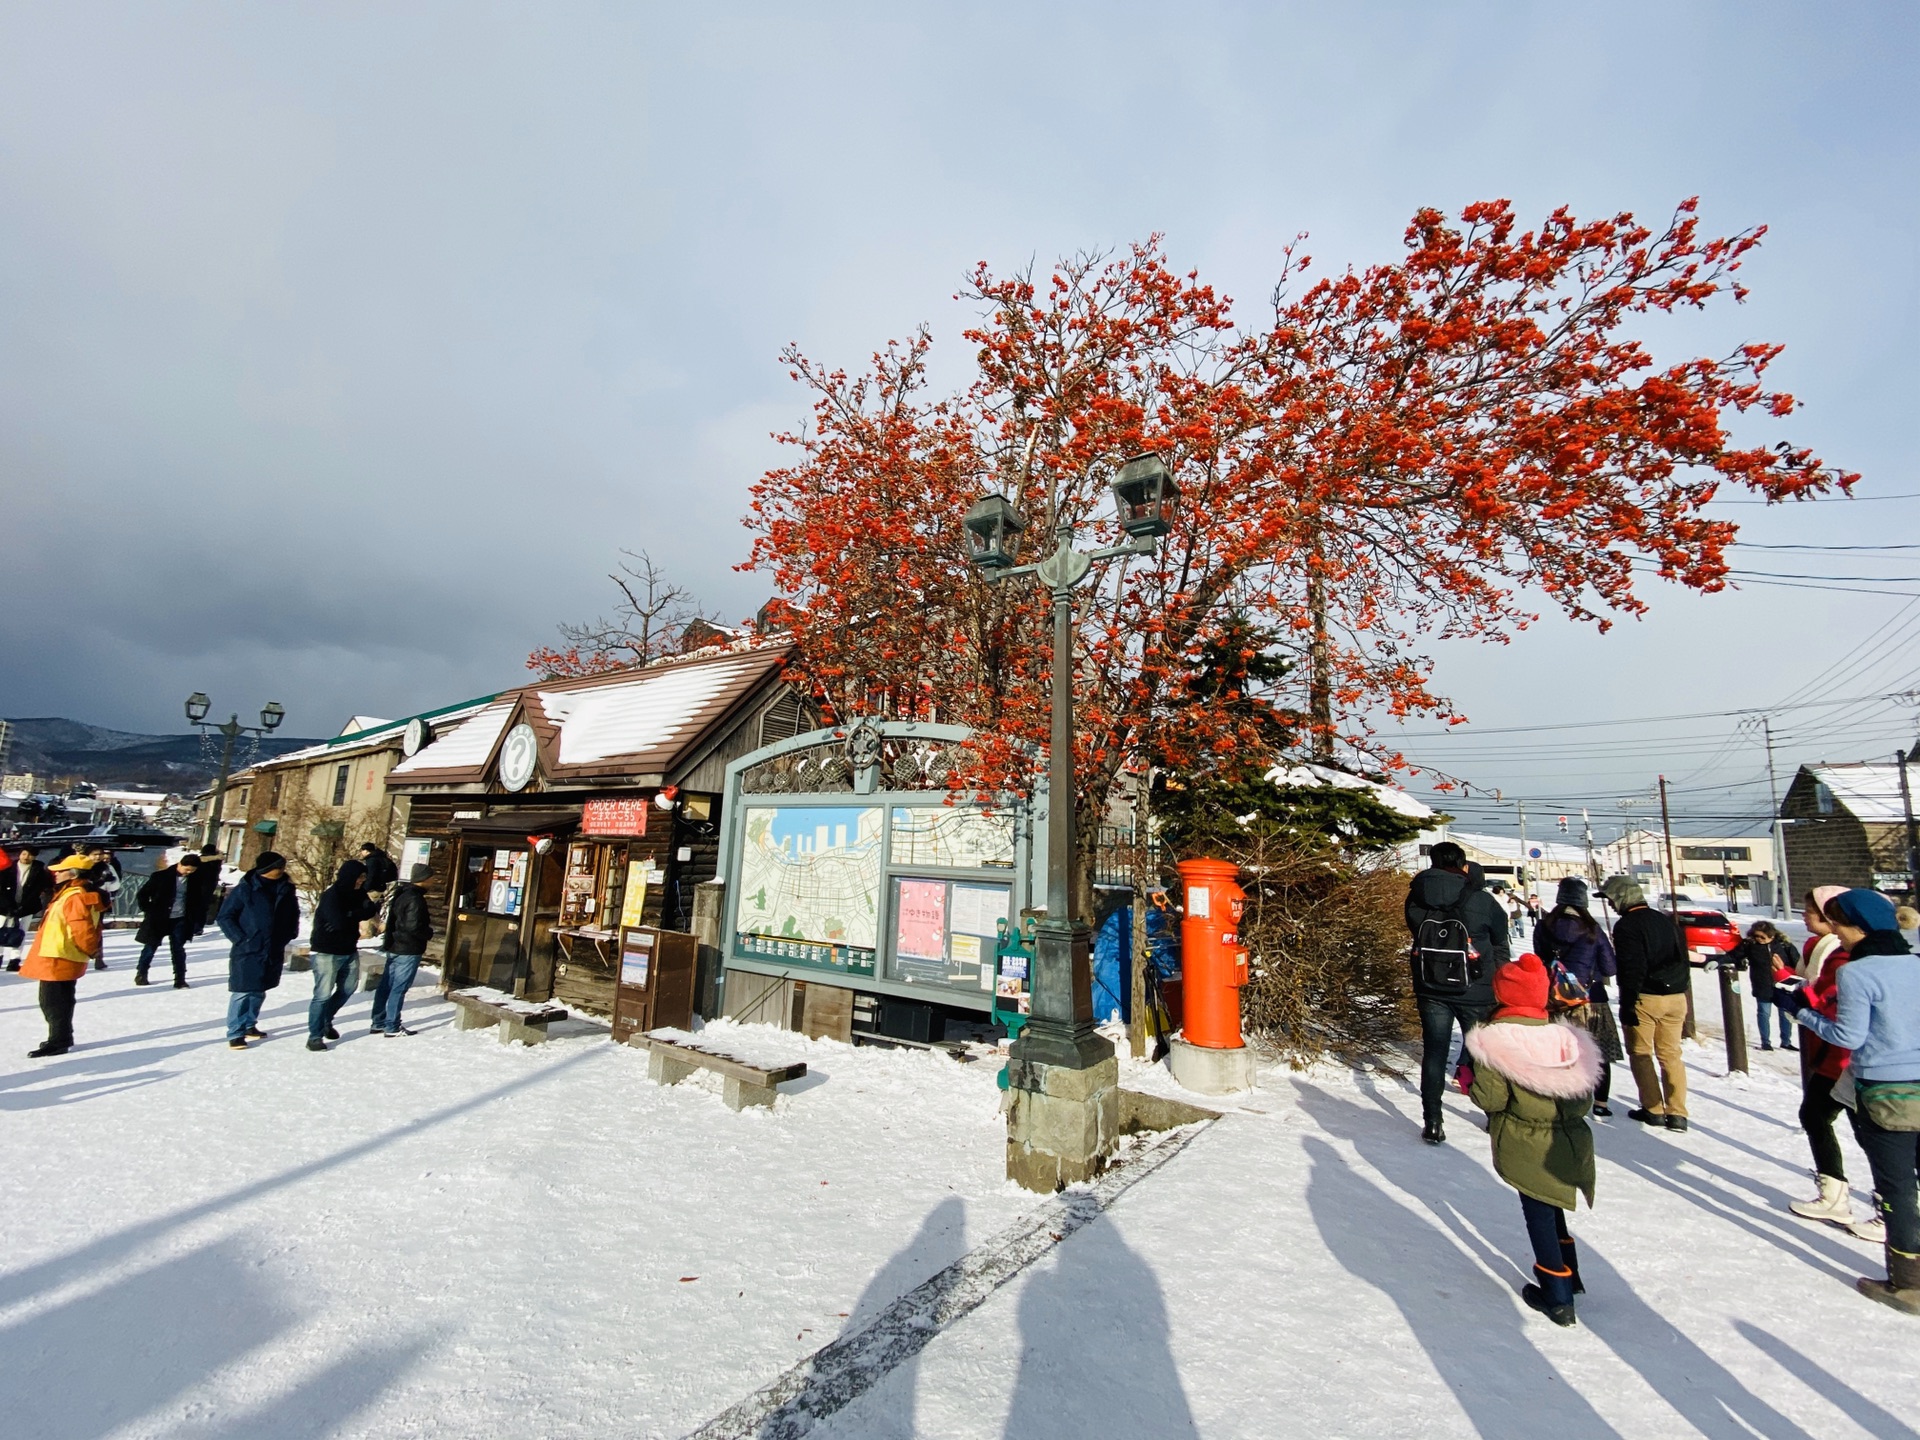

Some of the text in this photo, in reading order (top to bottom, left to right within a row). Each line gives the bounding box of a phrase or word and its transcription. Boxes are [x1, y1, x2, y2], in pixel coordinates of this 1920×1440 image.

[588, 798, 644, 811] ORDER HERE
[591, 810, 635, 821] ご注文はこちら
